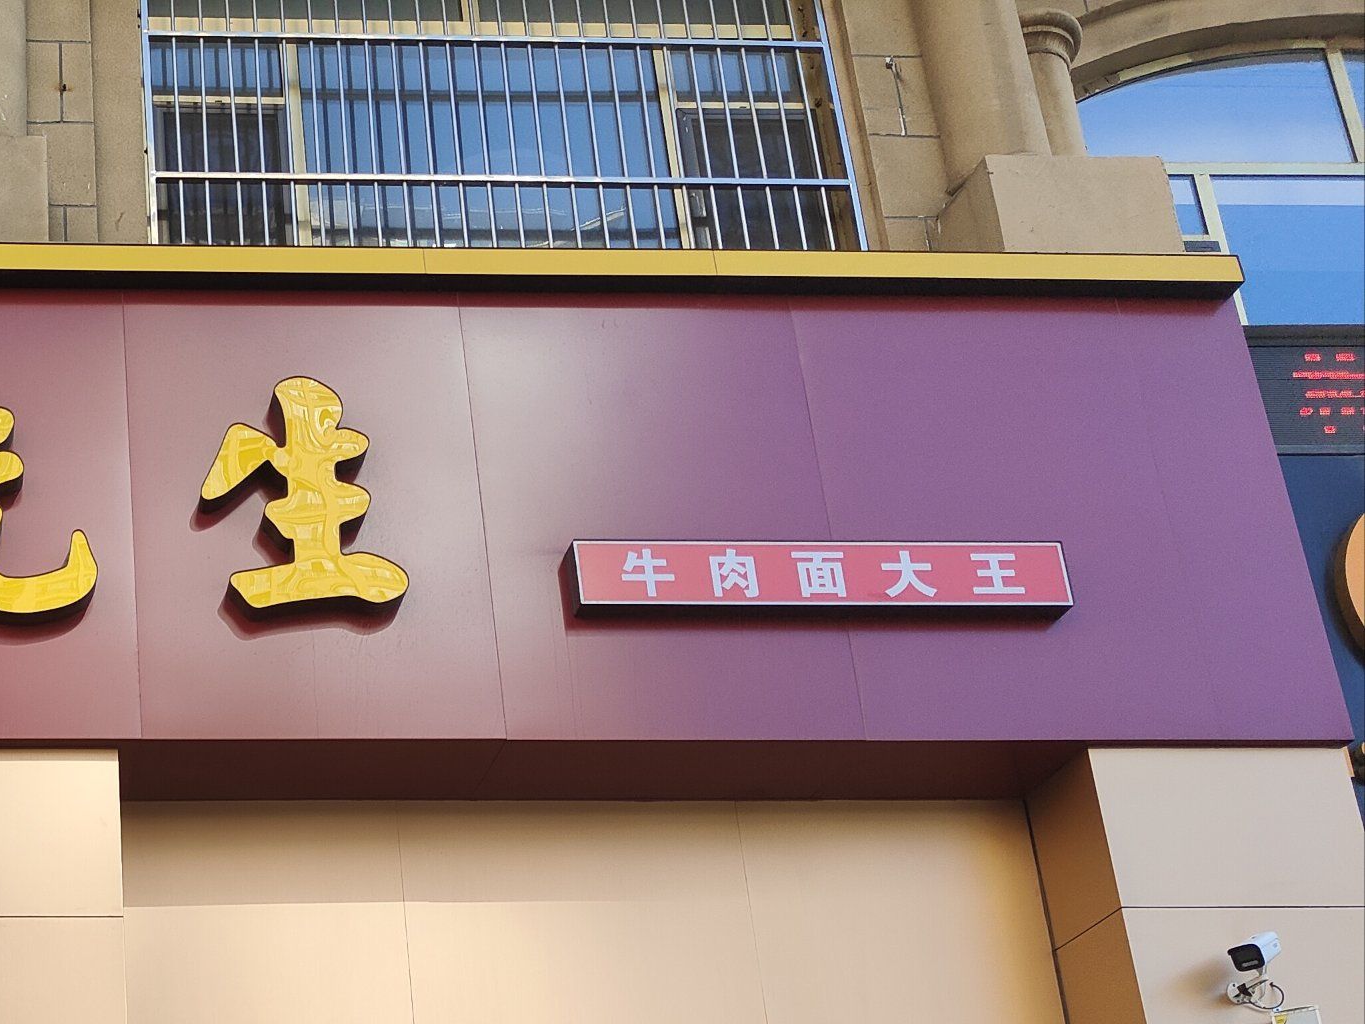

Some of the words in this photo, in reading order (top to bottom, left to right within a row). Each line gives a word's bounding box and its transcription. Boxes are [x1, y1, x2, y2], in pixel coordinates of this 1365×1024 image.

[621, 548, 1027, 600] 牛肉面大王
